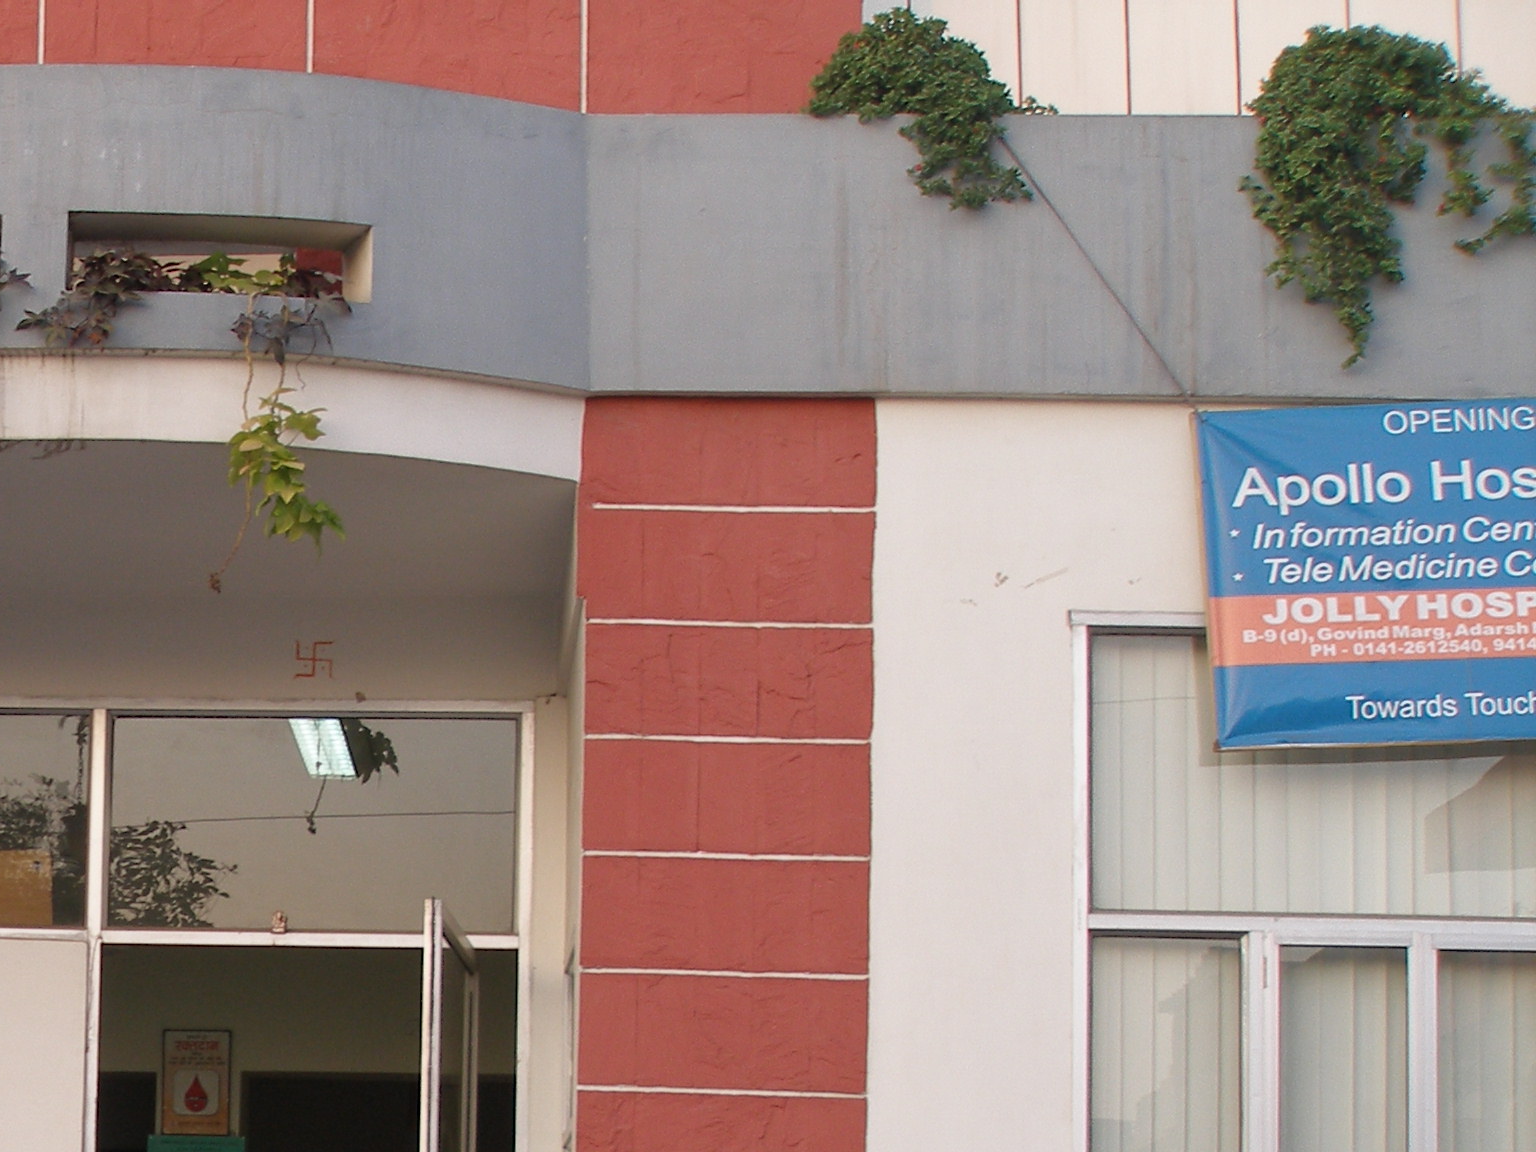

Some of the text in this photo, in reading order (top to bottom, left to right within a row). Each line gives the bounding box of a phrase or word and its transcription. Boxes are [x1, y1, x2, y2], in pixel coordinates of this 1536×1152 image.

[1382, 406, 1536, 434] OPENING
[1232, 463, 1411, 515] Apollo
[1253, 516, 1536, 550] Information Cen
[1264, 556, 1334, 584] Tele
[1338, 551, 1498, 583] Medicine
[1262, 591, 1536, 625] JOLLY HOSP
[1317, 626, 1389, 641] Govind
[1392, 625, 1451, 641] Marg,
[1454, 622, 1529, 637] Adarsh
[1310, 643, 1337, 657] PH
[1345, 694, 1458, 719] Towards
